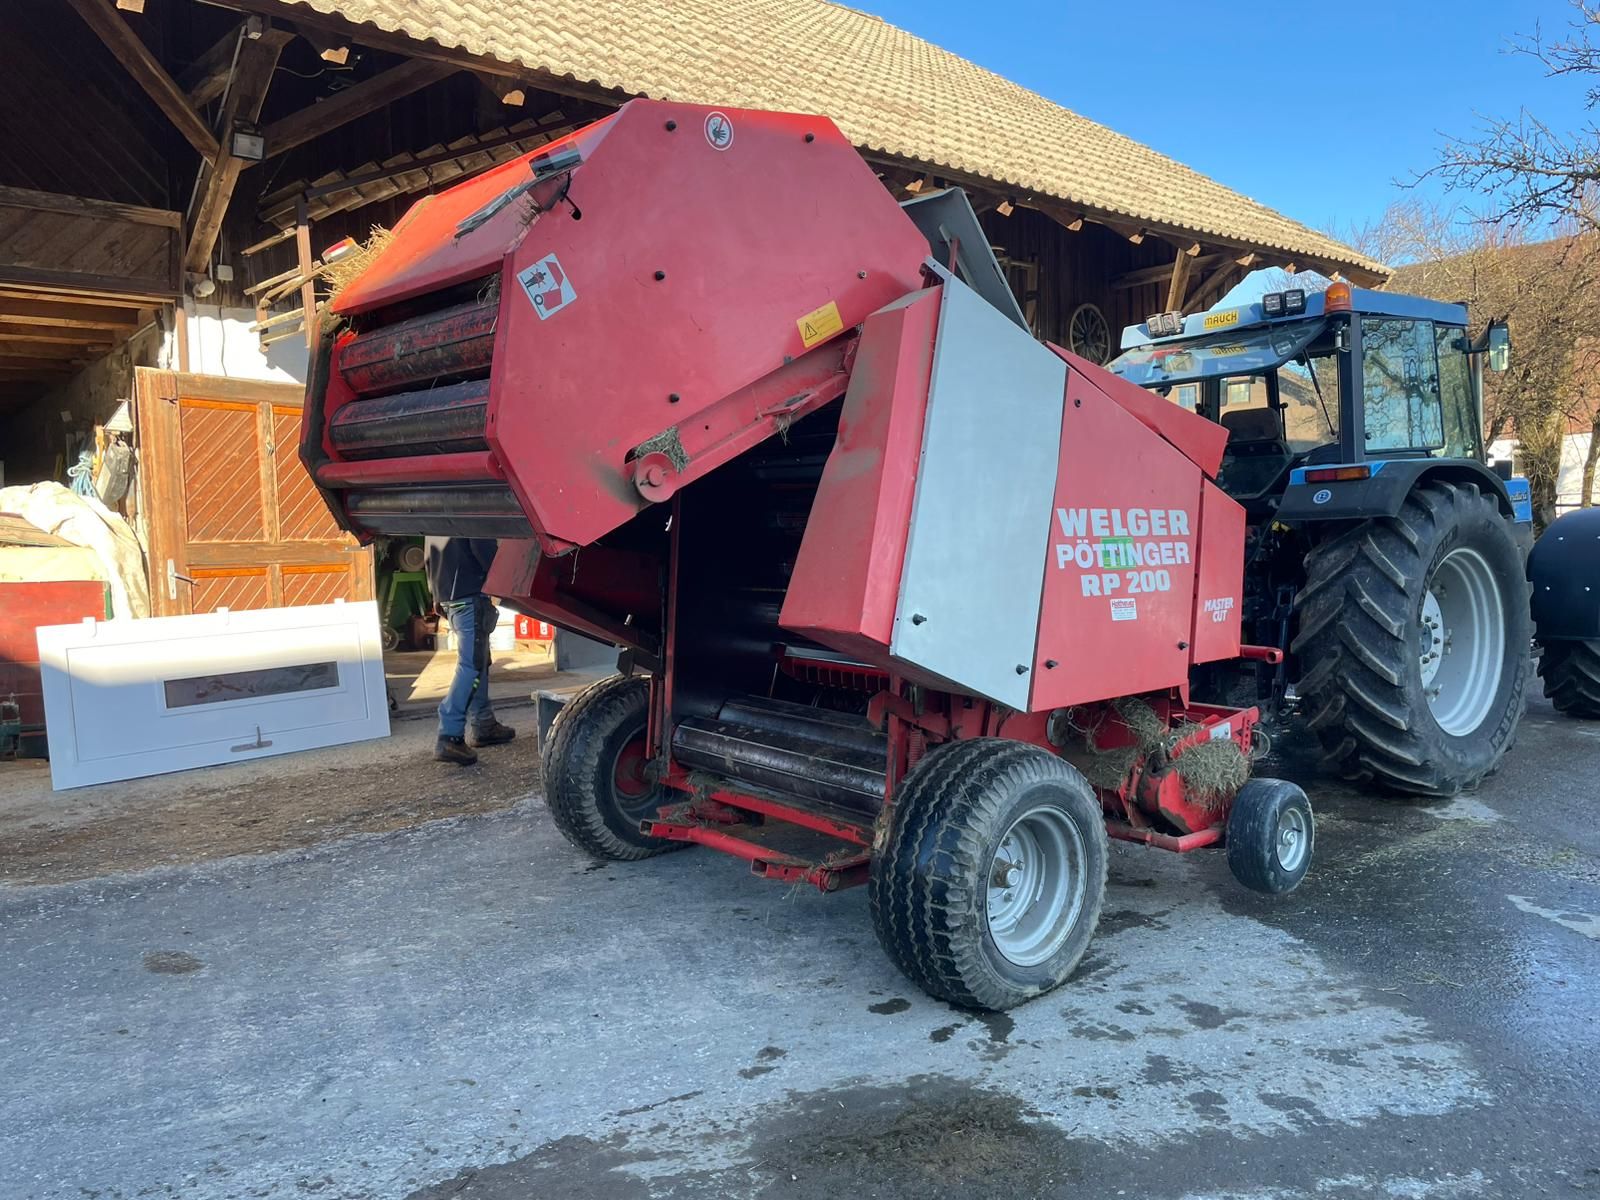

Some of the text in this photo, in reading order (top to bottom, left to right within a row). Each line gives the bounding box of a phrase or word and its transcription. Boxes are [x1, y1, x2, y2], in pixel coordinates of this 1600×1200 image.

[1205, 311, 1237, 326] MAUCH
[1056, 508, 1190, 537] WELGER
[1056, 539, 1190, 569] PÖTTINGER
[1080, 570, 1171, 597] RP 200
[1204, 597, 1234, 612] MASTER
[1212, 609, 1229, 623] CUT
